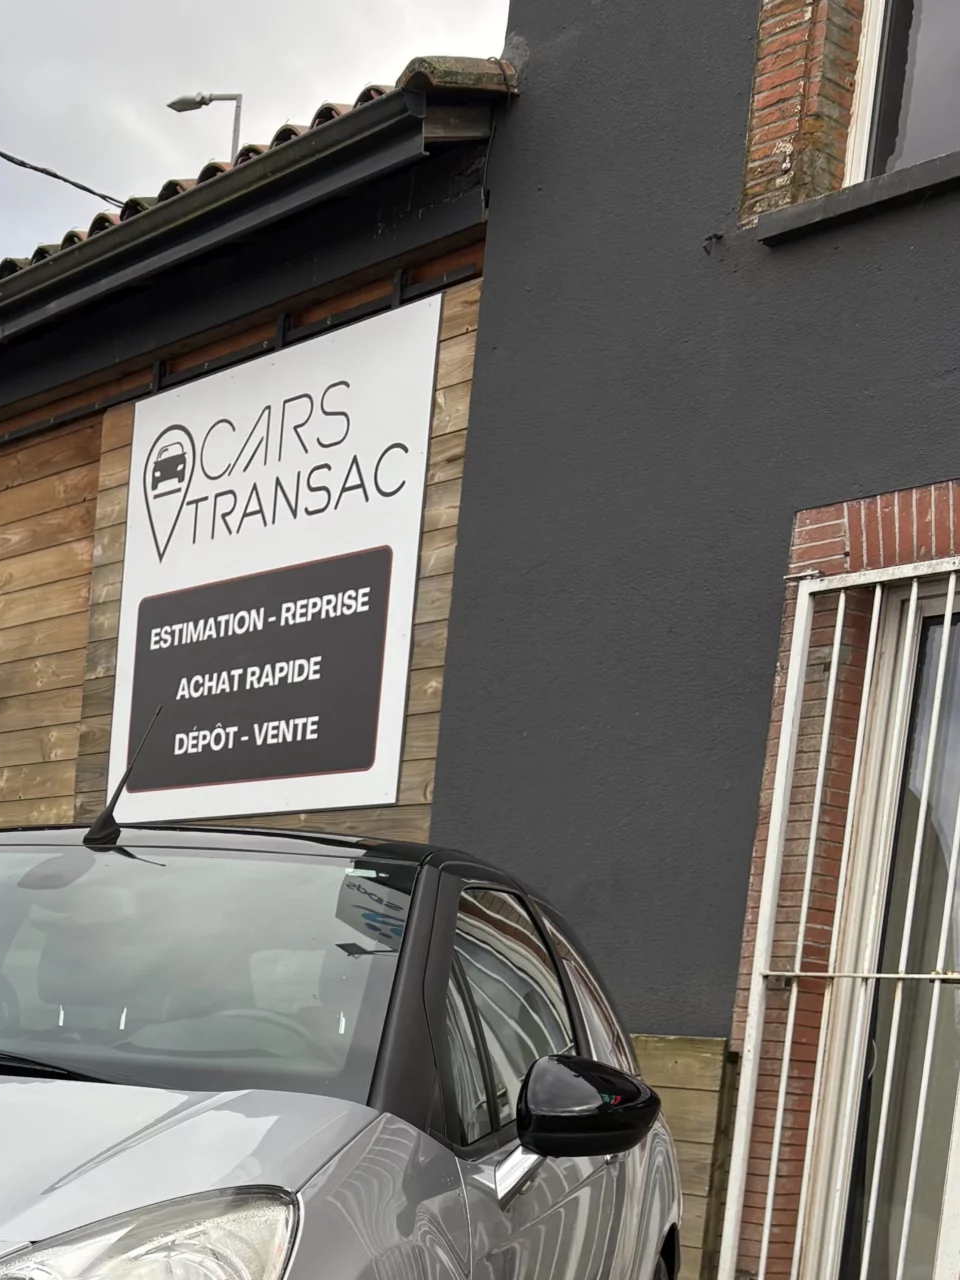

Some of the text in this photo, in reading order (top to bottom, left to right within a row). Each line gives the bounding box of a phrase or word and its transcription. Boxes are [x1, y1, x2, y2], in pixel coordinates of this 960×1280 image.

[199, 379, 350, 480] CARS
[186, 442, 409, 544] TRANSAC
[149, 607, 265, 650] ESTIMATION
[280, 587, 371, 627] REPRISE
[176, 656, 322, 700] ACHAT RAPIDE
[173, 722, 238, 755] DÉPÔT
[253, 716, 320, 746] VENTE
